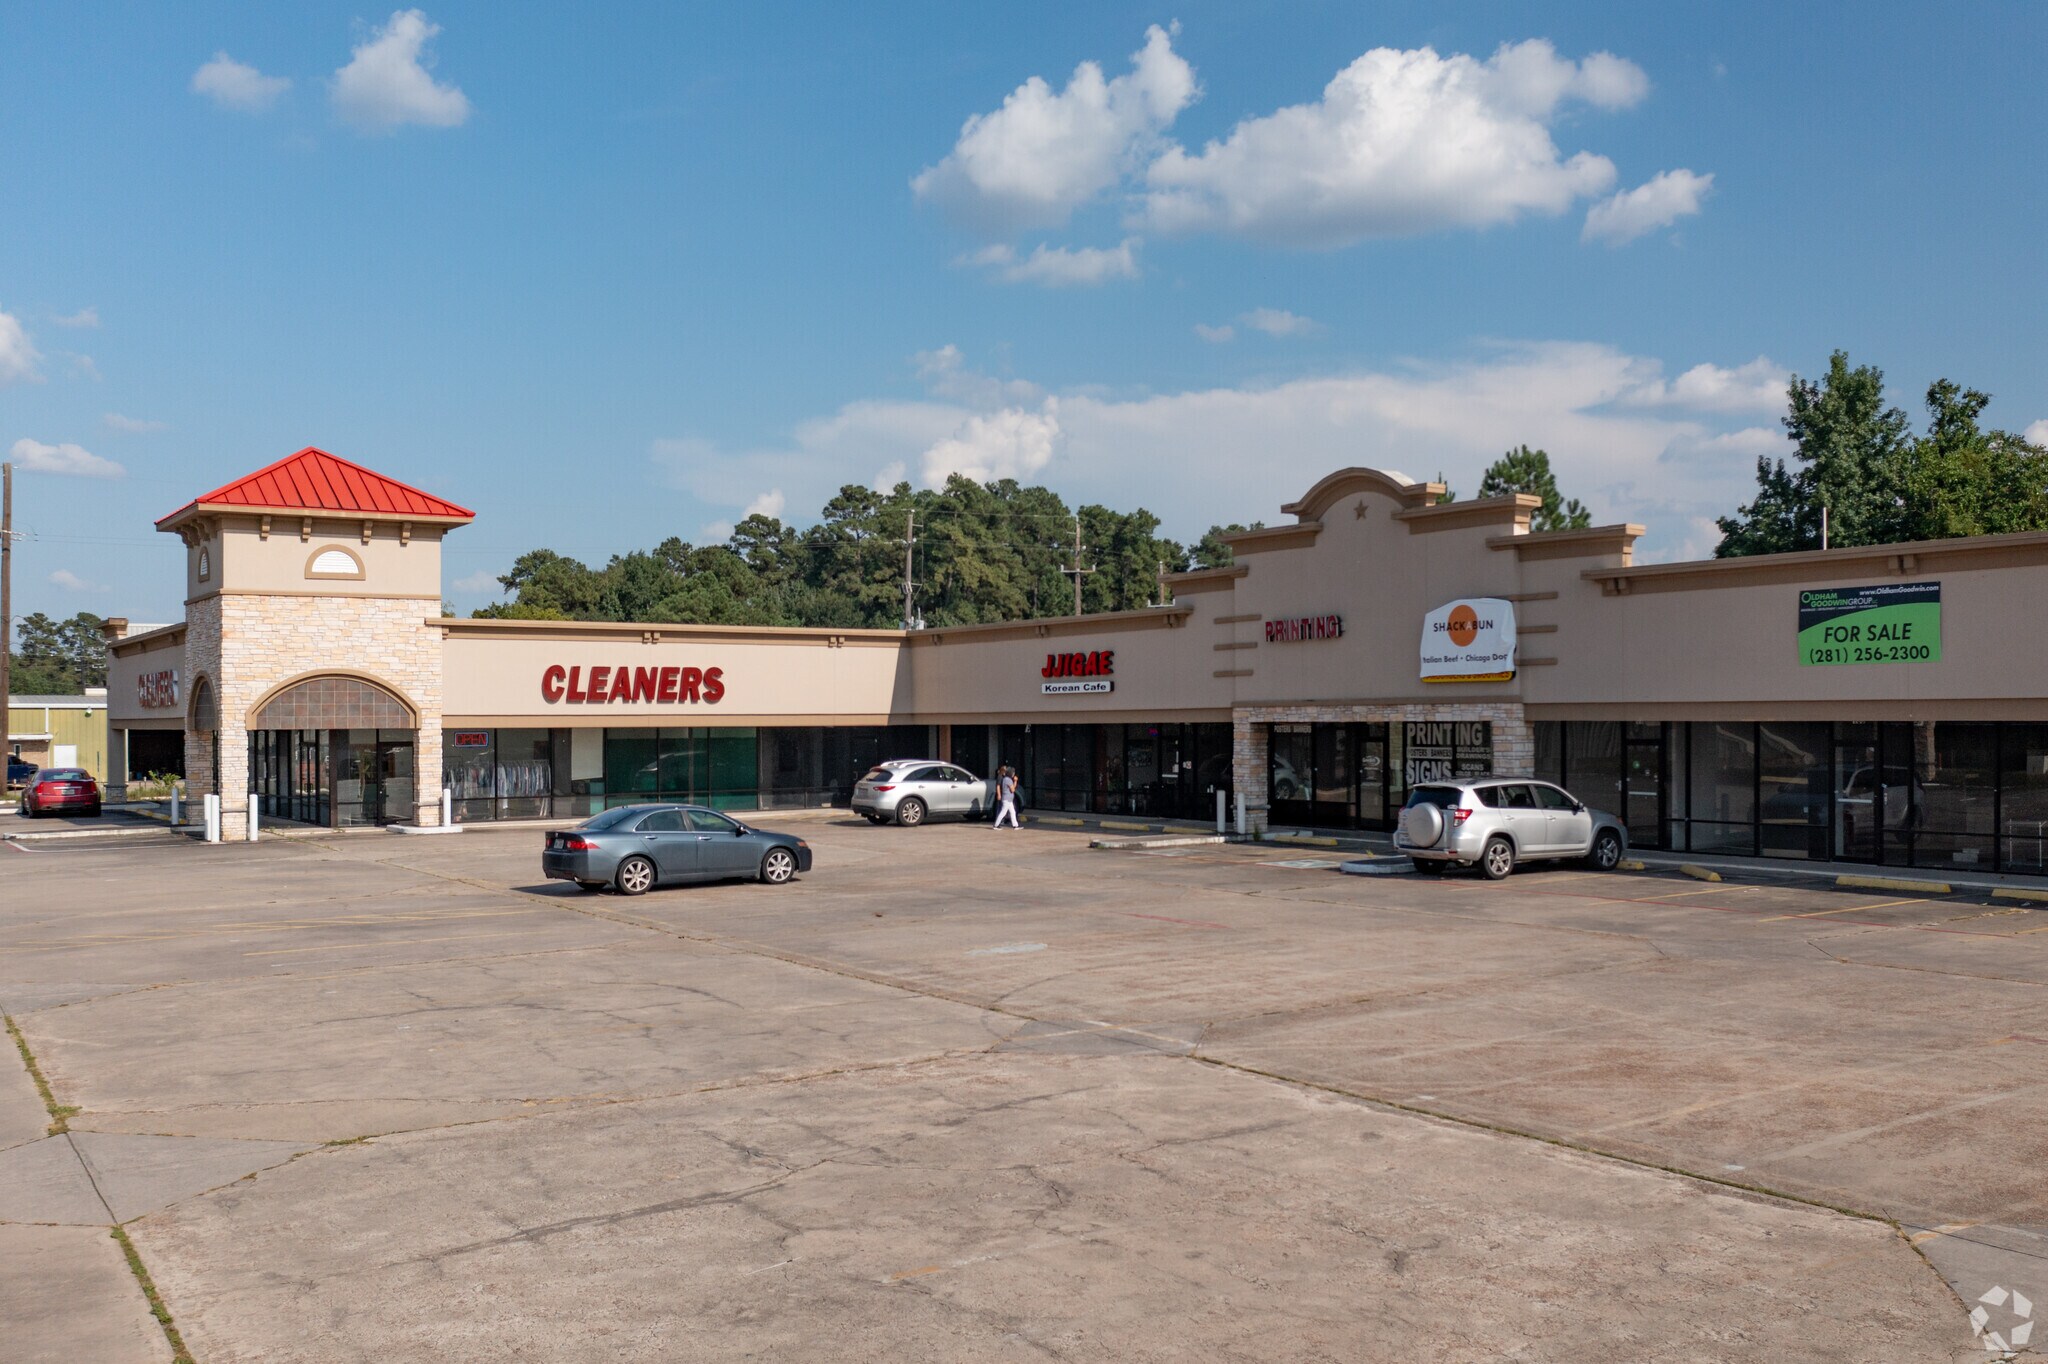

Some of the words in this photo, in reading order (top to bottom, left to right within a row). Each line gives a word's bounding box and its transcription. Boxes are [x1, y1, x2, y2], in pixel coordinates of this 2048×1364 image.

[1801, 592, 1838, 603] OLDHAM
[1859, 585, 1939, 596] www.OldhamGoodwin.com
[1265, 615, 1341, 641] PRINTING
[1824, 625, 1860, 643] FOR
[1867, 623, 1912, 641] SALE
[1444, 655, 1459, 663] Beef
[1466, 654, 1490, 663] Chicago
[1810, 647, 1848, 664] (281)
[1854, 645, 1929, 661] 256-2300
[1041, 651, 1114, 678] JJIGAE
[541, 664, 725, 704] CLEANERS
[1083, 683, 1106, 691] Cafe
[456, 733, 487, 745] OPEN
[1407, 723, 1483, 746] PRINTING
[1430, 748, 1452, 758] BANNERS
[1406, 760, 1452, 783] SIGNS
[1461, 763, 1485, 771] SCANS
